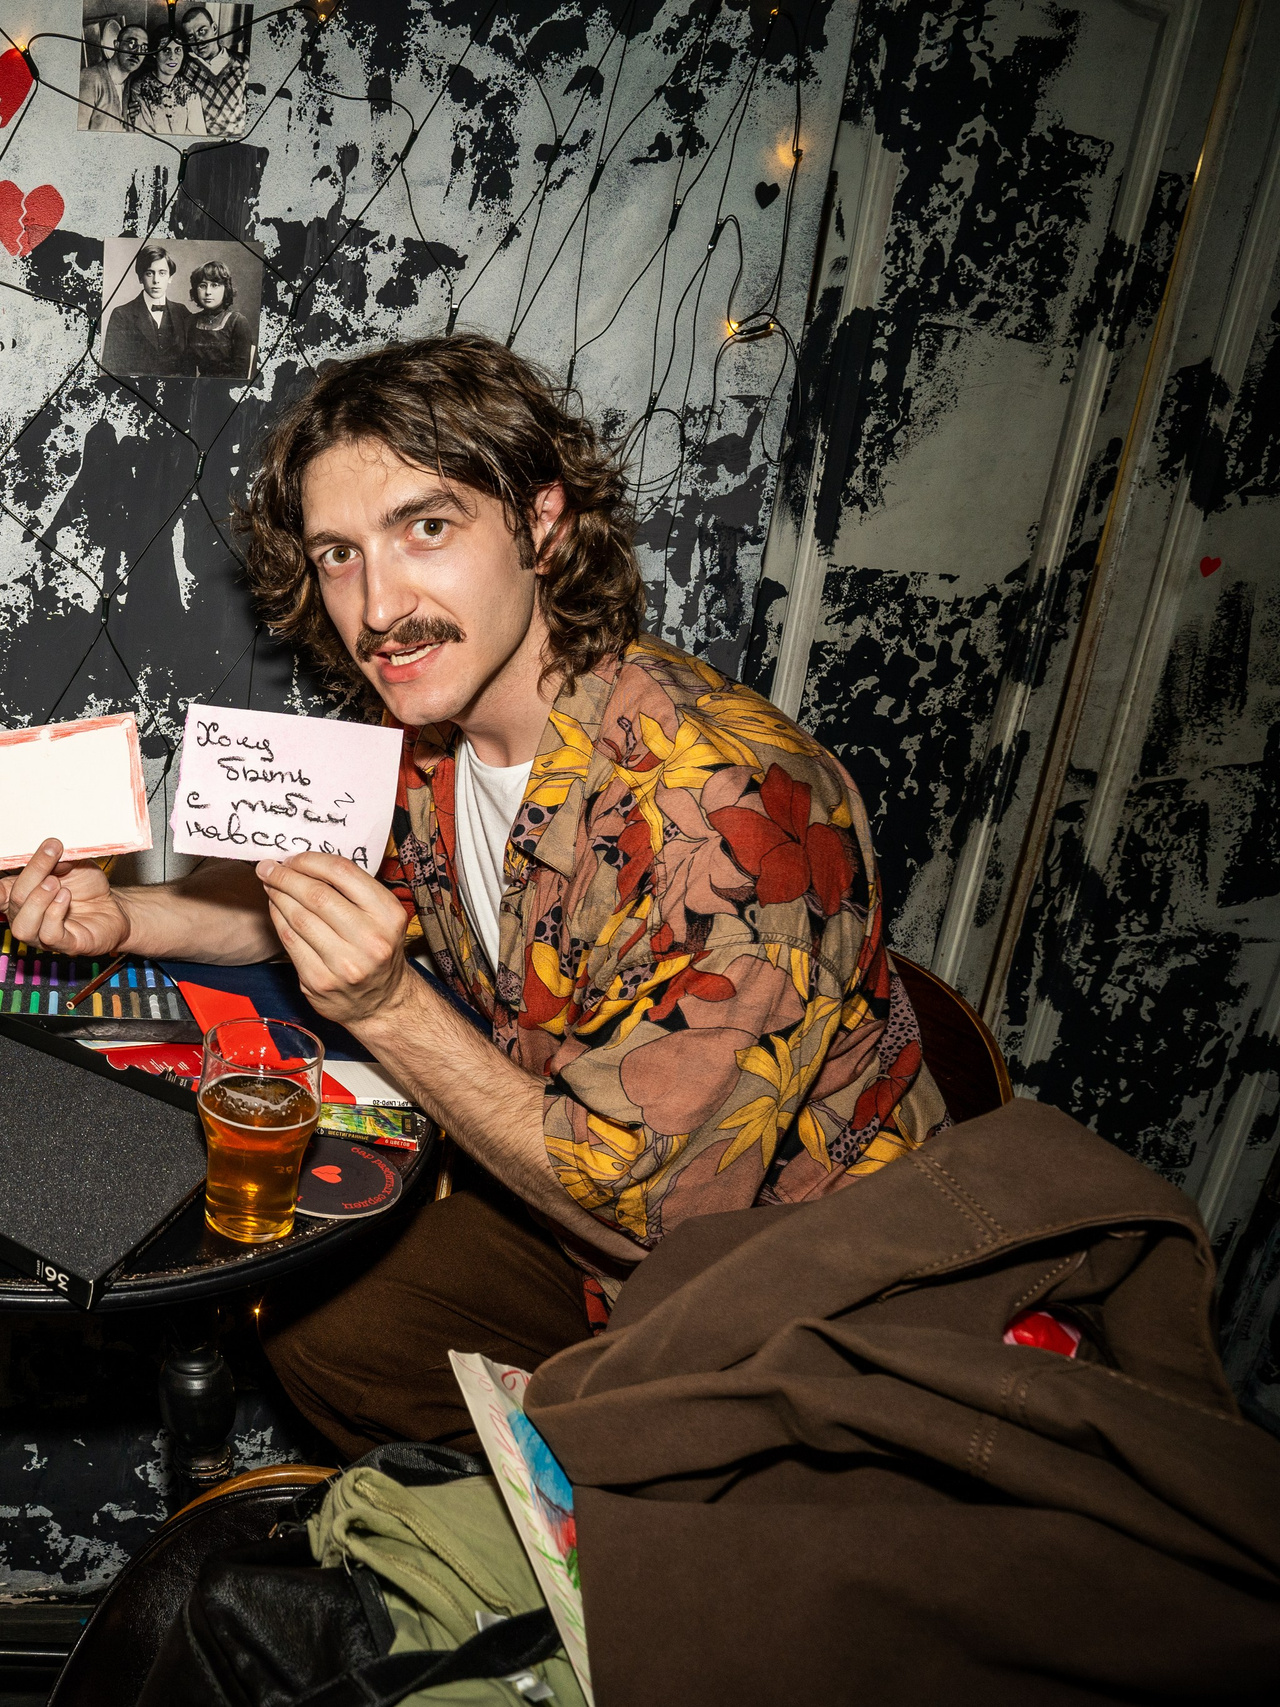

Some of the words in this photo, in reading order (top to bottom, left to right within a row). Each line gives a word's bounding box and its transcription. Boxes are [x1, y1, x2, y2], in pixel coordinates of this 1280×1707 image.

[196, 720, 275, 763] Хочу
[217, 755, 311, 786] быть
[186, 791, 211, 809] с
[231, 791, 356, 827] тобой
[351, 1146, 375, 1160] бар
[372, 1158, 395, 1195] разбитых
[342, 1194, 387, 1210] сердец
[44, 1265, 71, 1292] 36
